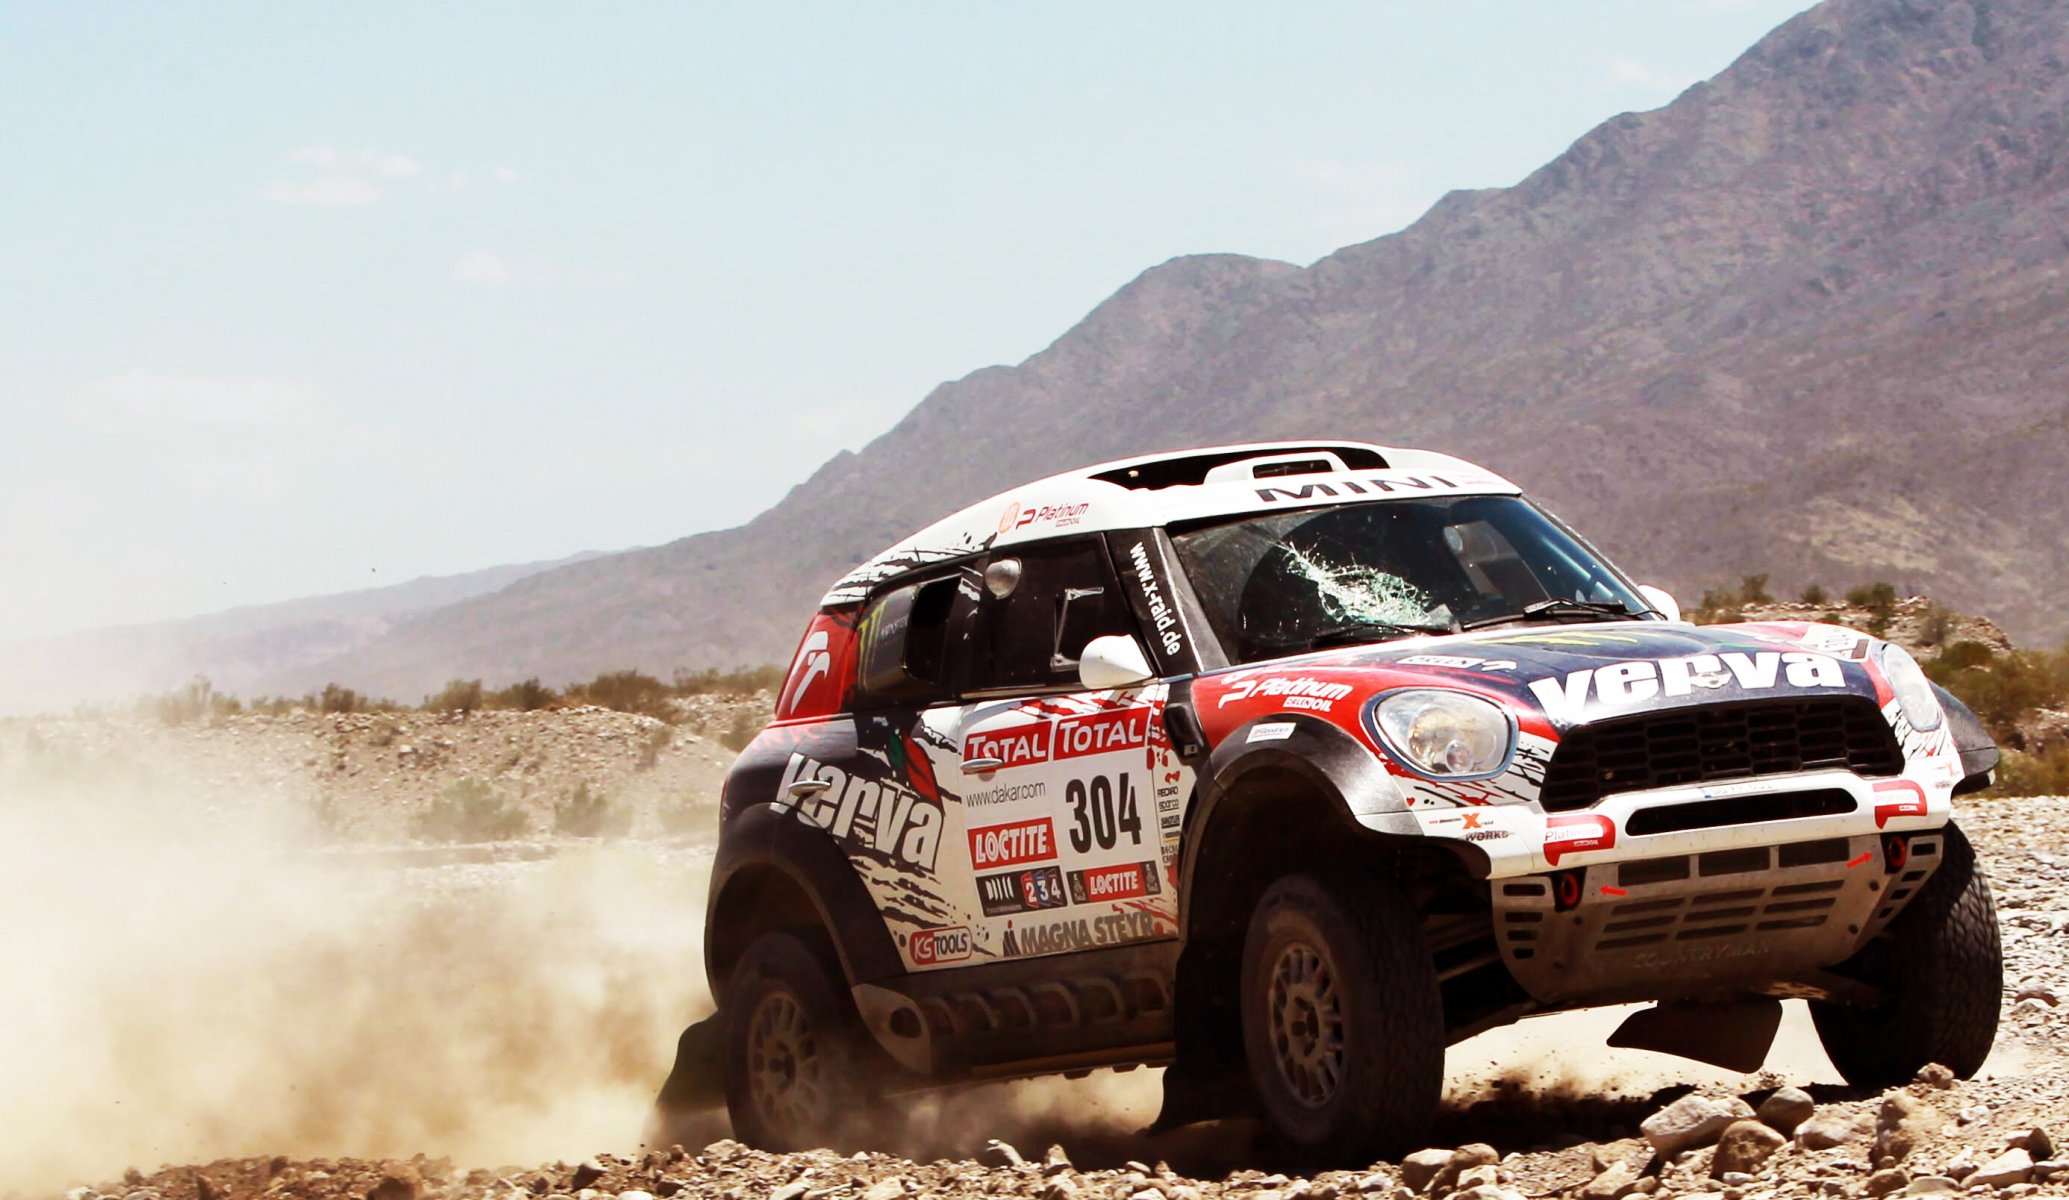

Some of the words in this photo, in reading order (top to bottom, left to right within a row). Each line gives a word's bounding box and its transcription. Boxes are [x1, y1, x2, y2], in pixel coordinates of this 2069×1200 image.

[1255, 476, 1457, 502] MINI
[1036, 503, 1090, 522] Platinum
[1130, 541, 1182, 656] www.x-raid.de
[1248, 677, 1354, 700] Platinum
[1527, 651, 1847, 726] verva
[1059, 719, 1144, 753] TOTAL
[966, 781, 1046, 808] www.dakar.com
[1065, 772, 1142, 854] 304
[975, 824, 1048, 861] LOCTITE
[1090, 871, 1138, 895] LOCTITE
[914, 935, 932, 959] KS
[933, 933, 968, 956] TOOLS
[1020, 919, 1094, 951] MAGNA
[1094, 911, 1154, 940] STEYR
